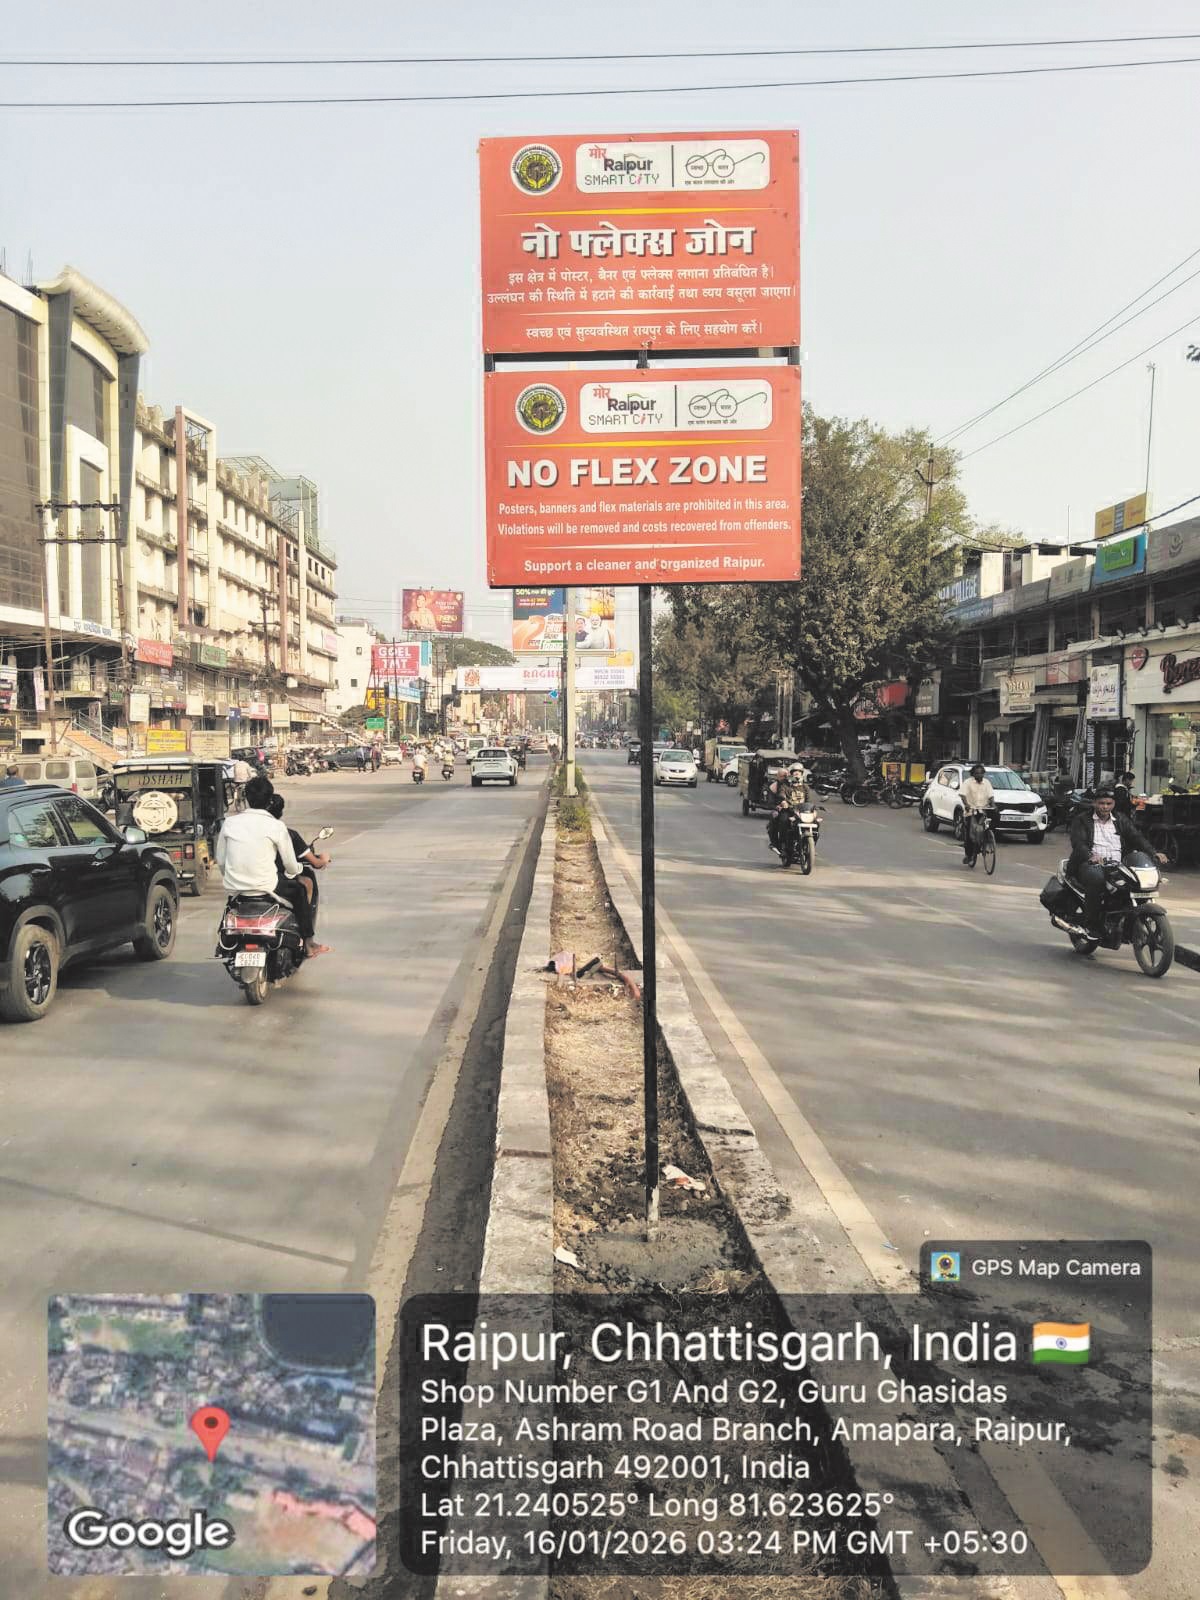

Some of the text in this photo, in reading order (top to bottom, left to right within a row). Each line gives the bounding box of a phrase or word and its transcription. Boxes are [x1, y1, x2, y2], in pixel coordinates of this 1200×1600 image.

[603, 157, 653, 175] Raipur
[584, 174, 626, 186] SMART
[521, 218, 756, 258] नो फ्लेक्स जोन
[508, 263, 774, 286] इस क्षेत्र में पोस्टर, बैनर एवं फ्लेक्स लगाना प्रतिबंधित है।
[487, 284, 796, 304] उल्लंघन की स्थिति में हटाने की कार्रवाई तथा व्यय वसूला जाएगा।
[526, 319, 762, 342] स्वच्छ एवं सुव्यवस्थित रायपुर के लिए सहयोग करें।
[607, 397, 656, 415] Raipur
[588, 414, 630, 426] SMART
[507, 455, 768, 488] NO FLEX ZONE
[499, 498, 790, 516] Posters, banners and flex materials are prohibited in this area.
[497, 518, 792, 535] Violations will be removed and costs recovered from offenders.
[524, 556, 766, 574] Support a cleaner and organized Raipur.
[378, 646, 411, 658] GOEL
[381, 658, 409, 669] TMT
